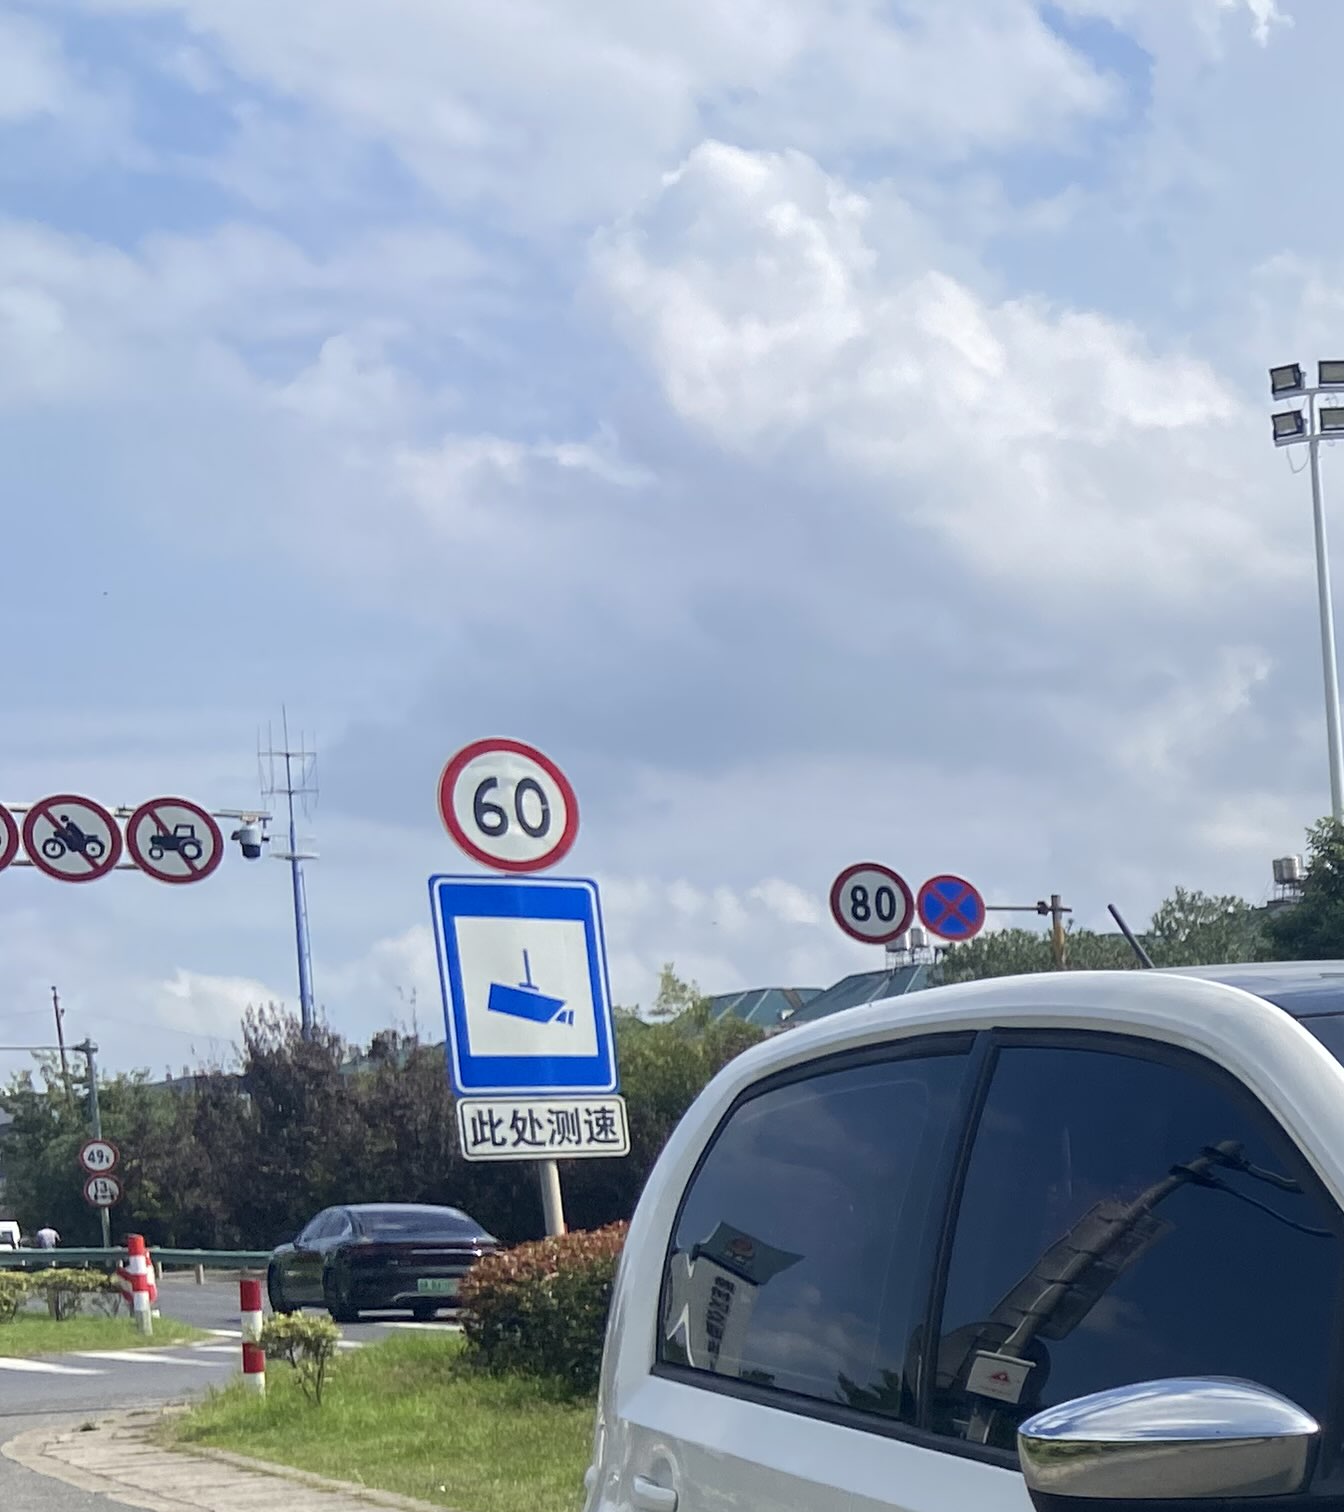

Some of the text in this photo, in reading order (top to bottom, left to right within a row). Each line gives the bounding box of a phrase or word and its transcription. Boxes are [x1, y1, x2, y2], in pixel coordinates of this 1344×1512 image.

[473, 777, 551, 838] 60
[851, 885, 896, 922] 80
[471, 1106, 619, 1147] 此处测速
